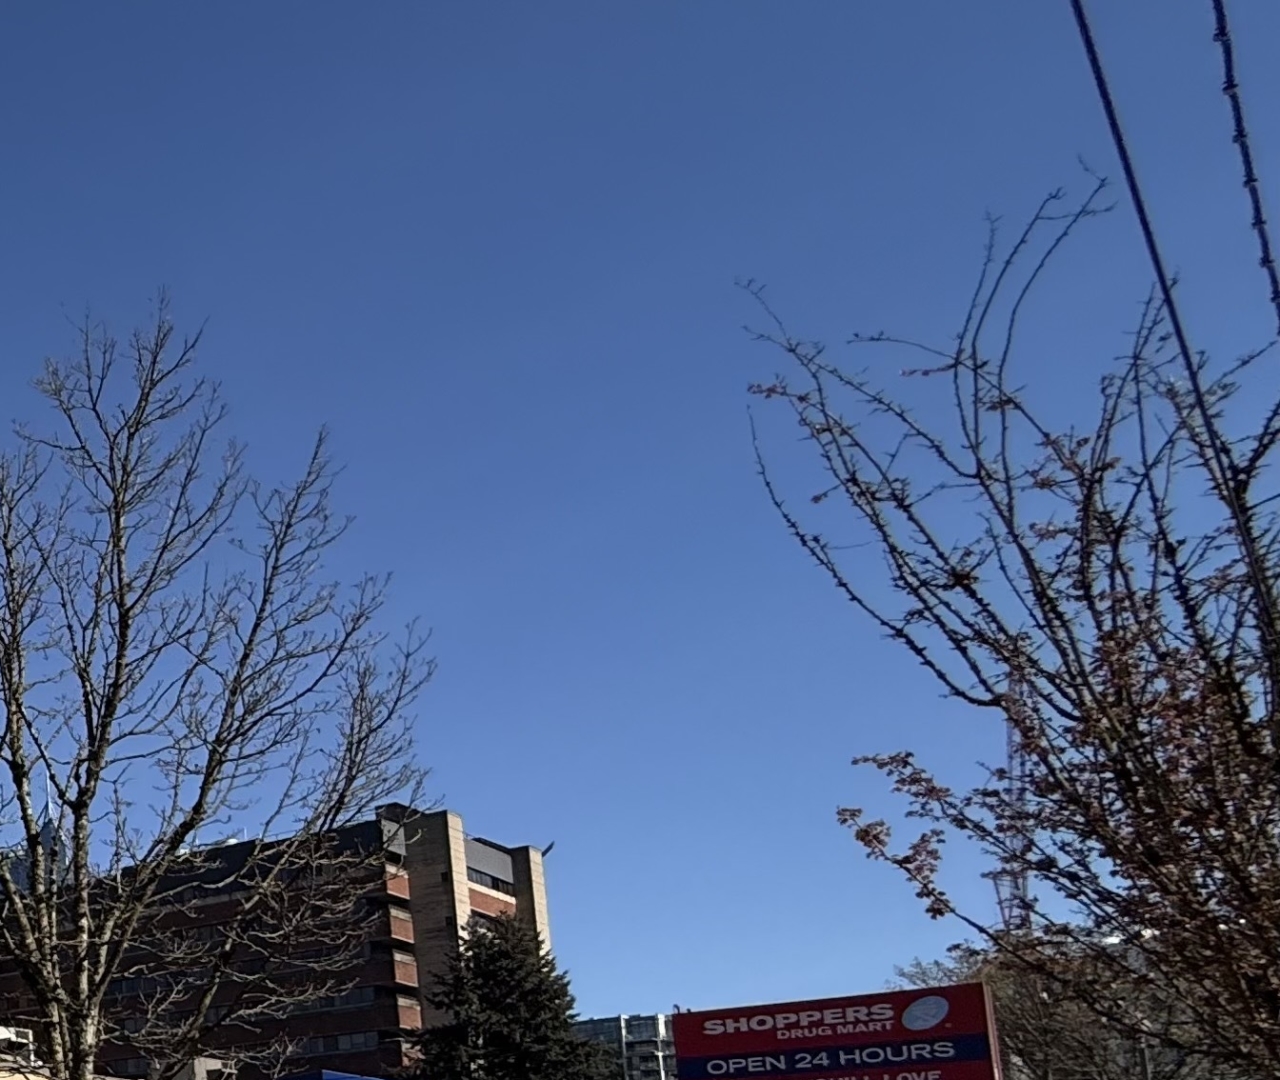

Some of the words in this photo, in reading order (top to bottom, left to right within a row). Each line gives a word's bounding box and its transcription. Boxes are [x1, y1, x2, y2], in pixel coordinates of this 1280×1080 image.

[703, 1003, 894, 1035] SHOPPERS
[777, 1026, 832, 1039] DRUG
[837, 1020, 894, 1035] MART
[707, 1055, 786, 1075] OPEN
[794, 1051, 830, 1069] 24
[839, 1042, 955, 1066] HOURS
